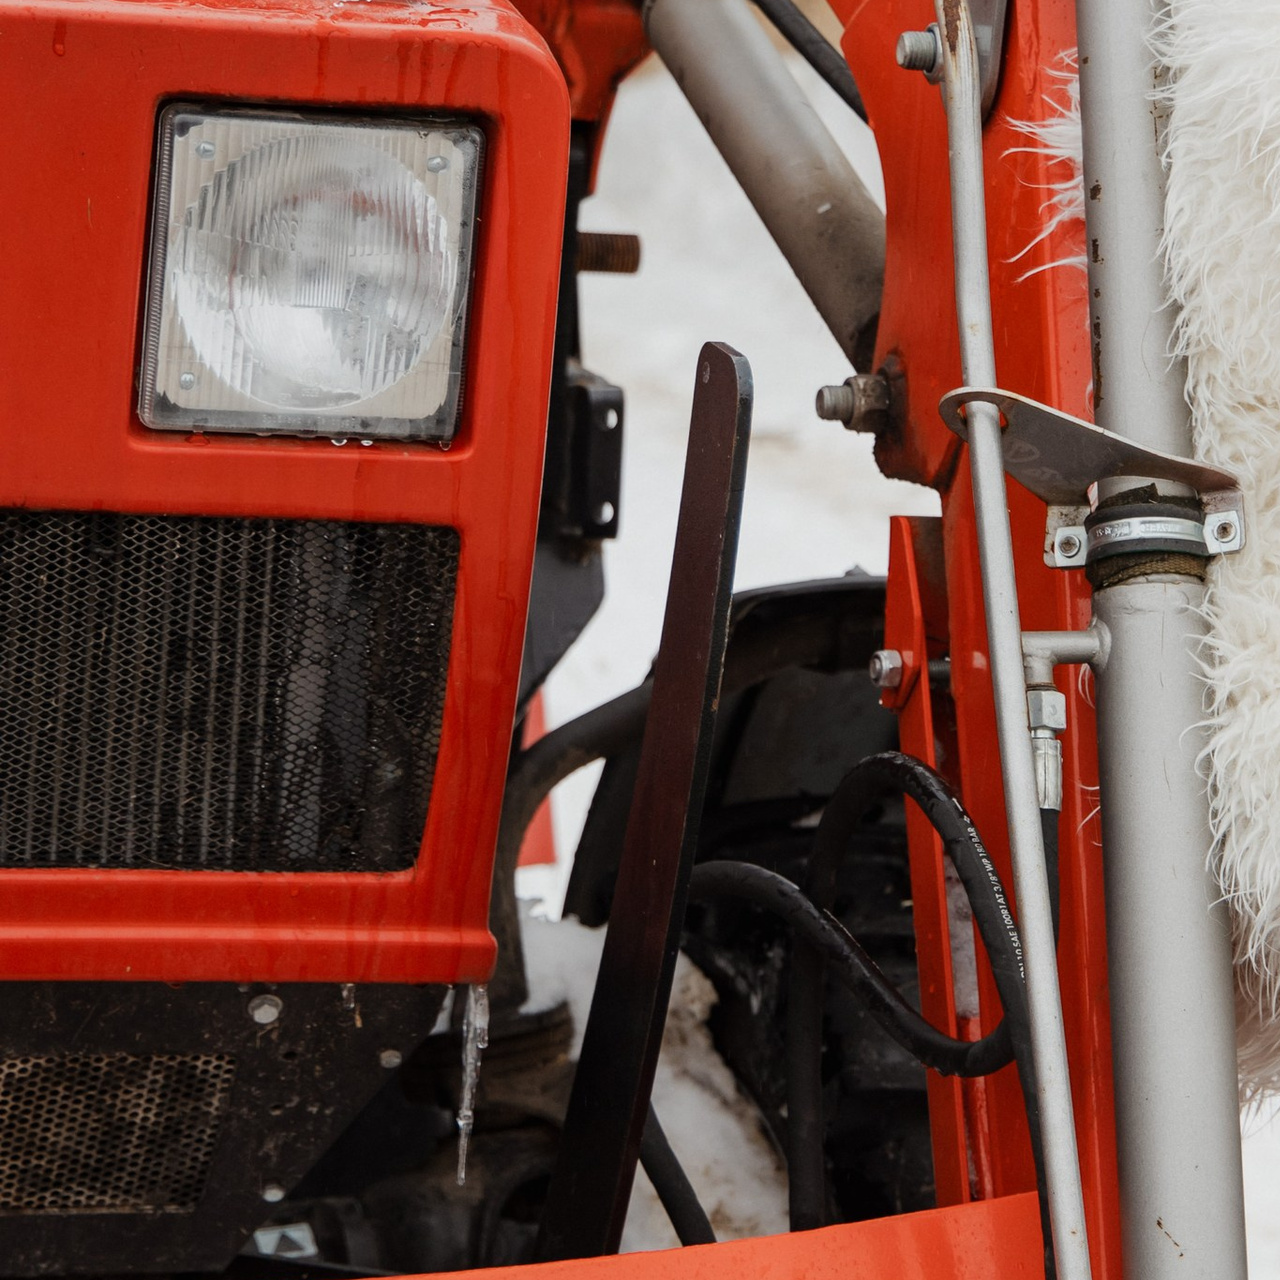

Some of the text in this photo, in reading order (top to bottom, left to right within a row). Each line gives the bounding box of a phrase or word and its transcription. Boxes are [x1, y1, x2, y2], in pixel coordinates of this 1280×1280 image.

[967, 827, 980, 842] BAR
[974, 843, 987, 857] 180
[981, 858, 994, 872] WP
[995, 893, 1014, 929] 100R1AT
[1009, 931, 1021, 947] SAE
